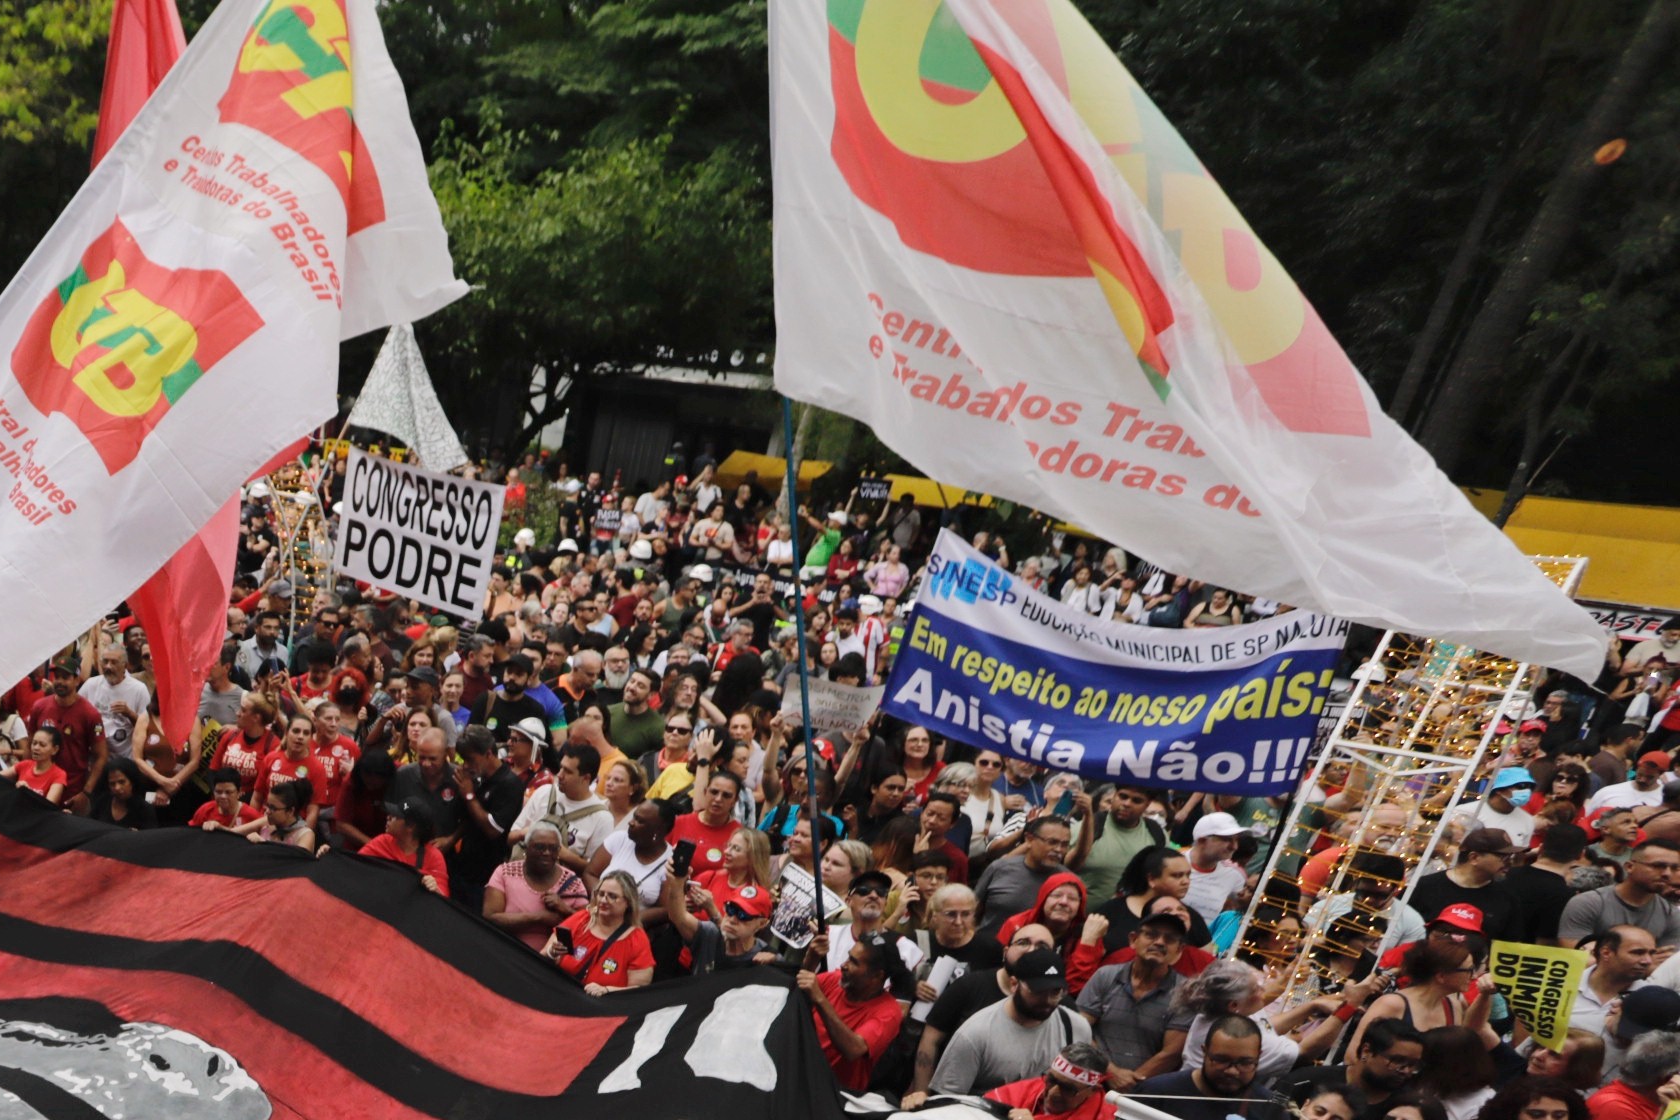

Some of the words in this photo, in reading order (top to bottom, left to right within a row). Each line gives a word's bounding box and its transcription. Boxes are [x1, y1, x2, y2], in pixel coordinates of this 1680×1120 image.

[163, 158, 180, 173] e
[242, 200, 273, 220] do
[271, 221, 335, 303] Brasil
[352, 456, 492, 550] CONGRESSO
[342, 518, 482, 611] PODRE
[927, 552, 1017, 608] SINESP
[1106, 634, 1205, 665] MUNICIPAL
[1211, 642, 1236, 663] DE
[1244, 634, 1269, 656] SP
[909, 614, 948, 662] Em
[951, 642, 1071, 709] respeito
[1074, 686, 1107, 720] ao
[1110, 691, 1207, 728] nosso
[1202, 658, 1334, 734] país:
[893, 668, 1086, 772] Anistia
[1106, 735, 1311, 784] Não!!!
[1494, 952, 1520, 978] DO
[1512, 956, 1549, 1033] INIMIGO
[1536, 960, 1570, 1039] CONGRESSO
